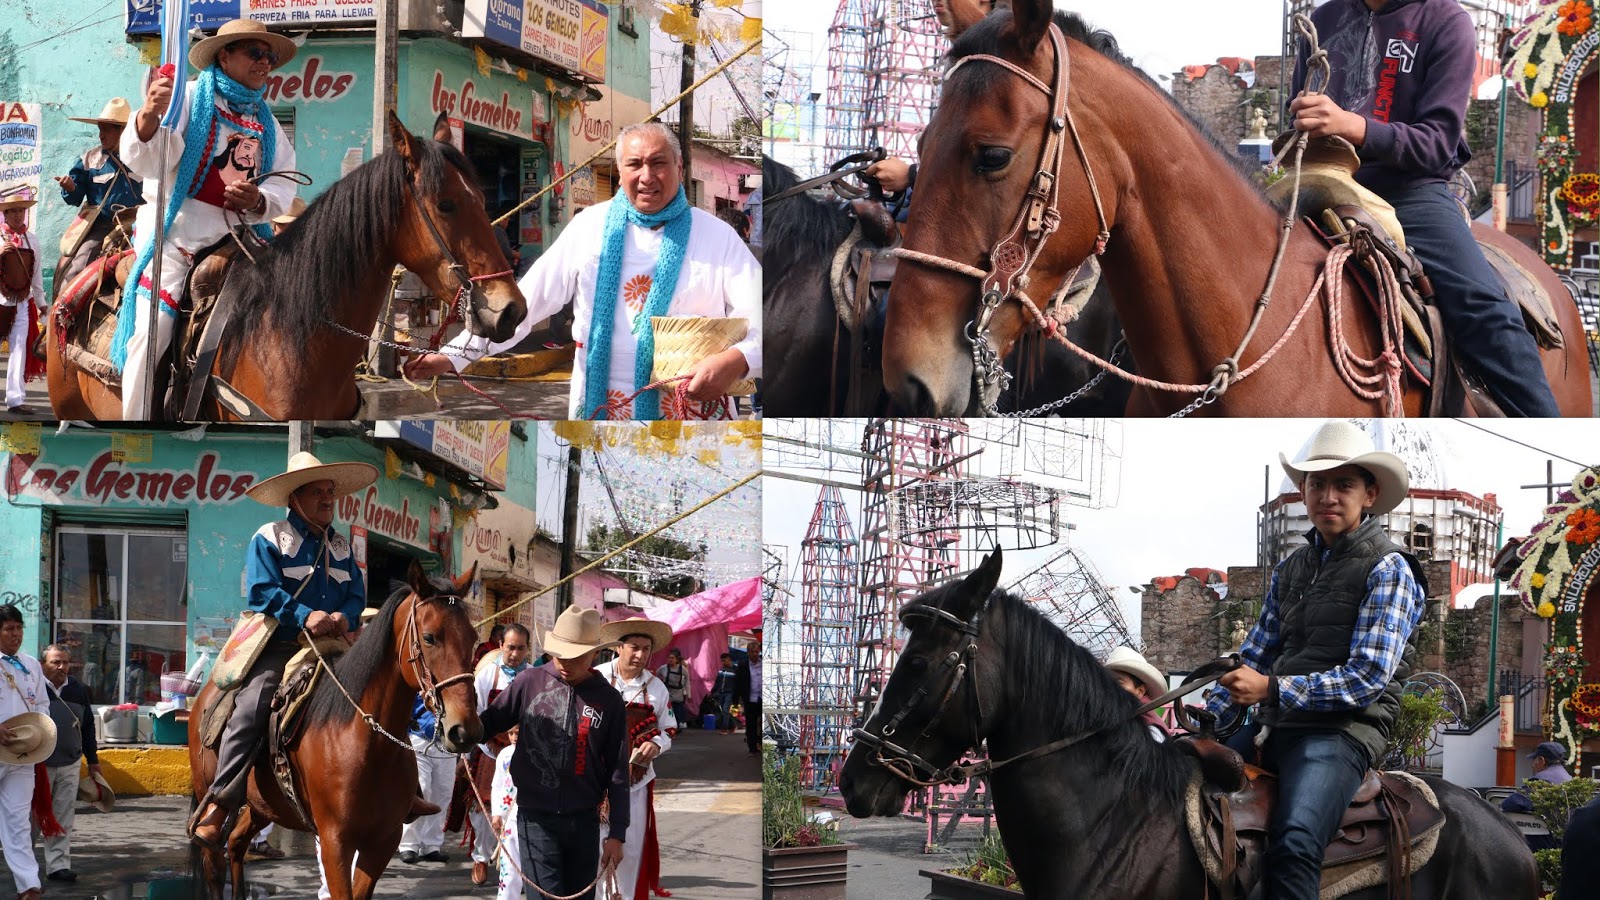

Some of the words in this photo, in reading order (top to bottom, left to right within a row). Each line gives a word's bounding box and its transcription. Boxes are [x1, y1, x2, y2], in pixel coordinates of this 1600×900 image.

[291, 10, 310, 20] FRIA
[315, 8, 337, 19] PARA
[343, 7, 374, 18] LLEVAR
[460, 81, 521, 130] Gemelos
[85, 450, 254, 504] Gemelos
[364, 486, 419, 541] Gemelos
